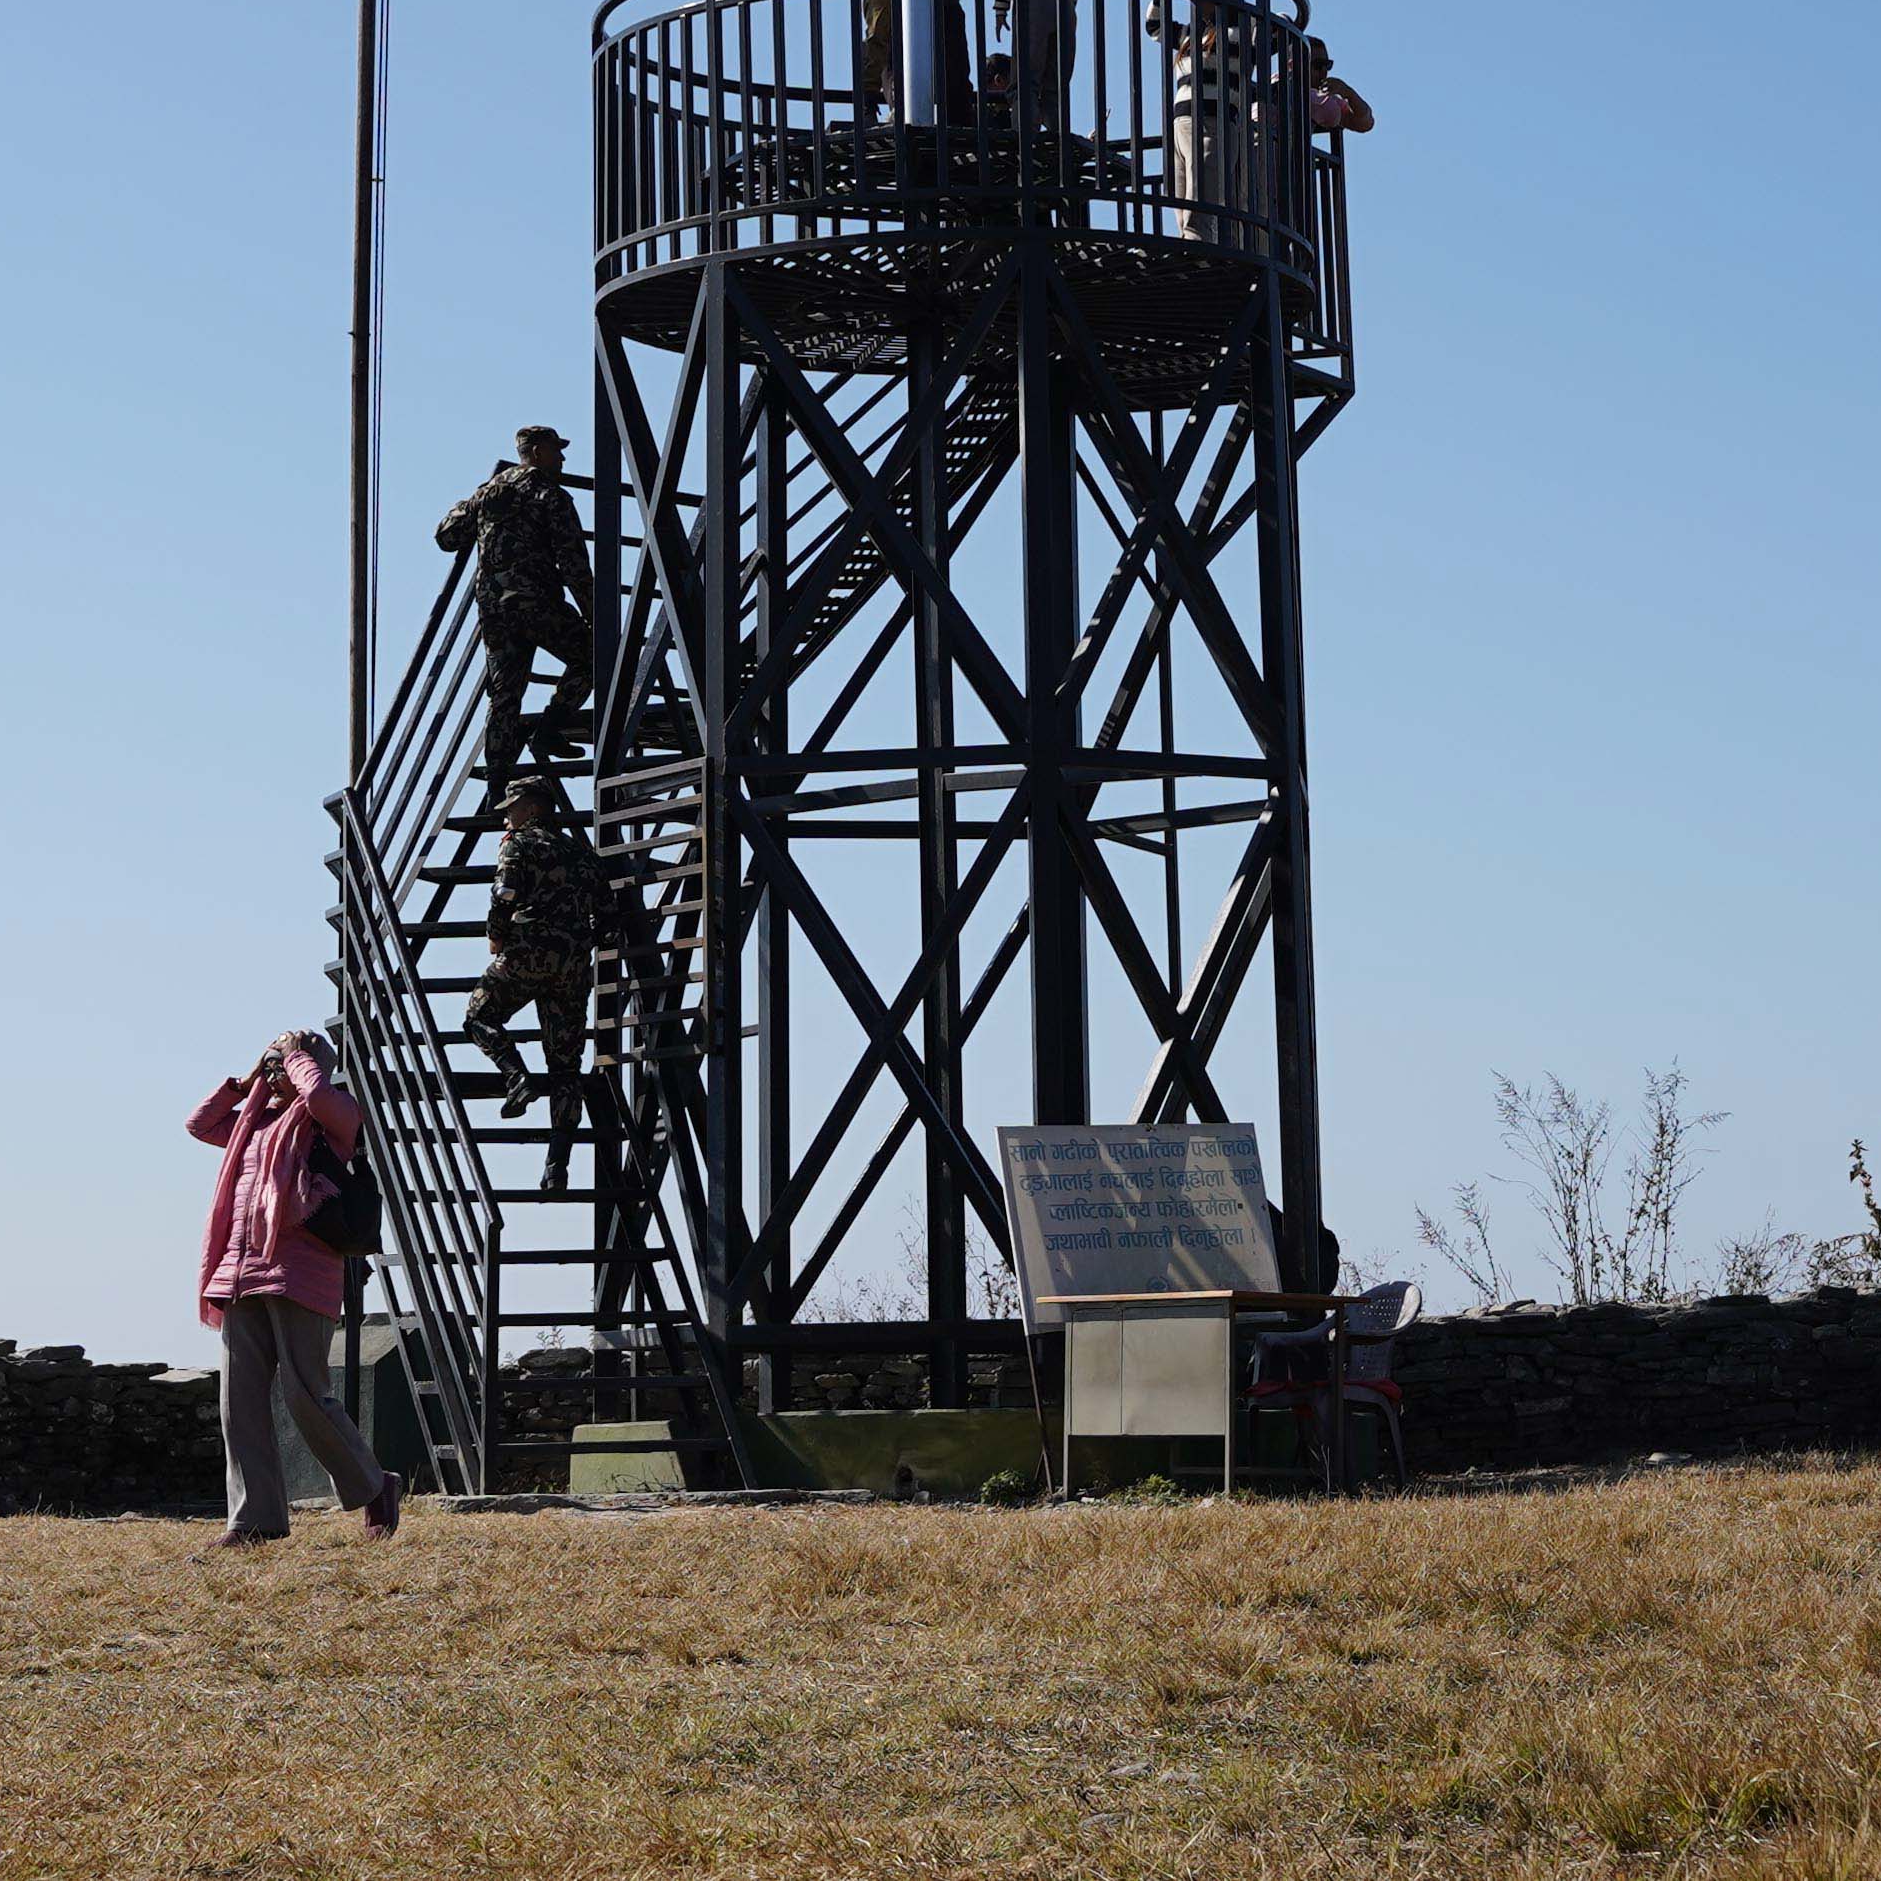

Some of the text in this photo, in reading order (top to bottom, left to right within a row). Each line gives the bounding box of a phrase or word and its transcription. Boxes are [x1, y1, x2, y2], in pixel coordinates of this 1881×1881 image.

[1009, 1138, 1047, 1162] सानो
[1050, 1137, 1102, 1161] गढीको
[1158, 1164, 1225, 1191] दिनुहोला
[1115, 1225, 1174, 1249] नफाली
[1177, 1223, 1243, 1251] दिनुहोला
